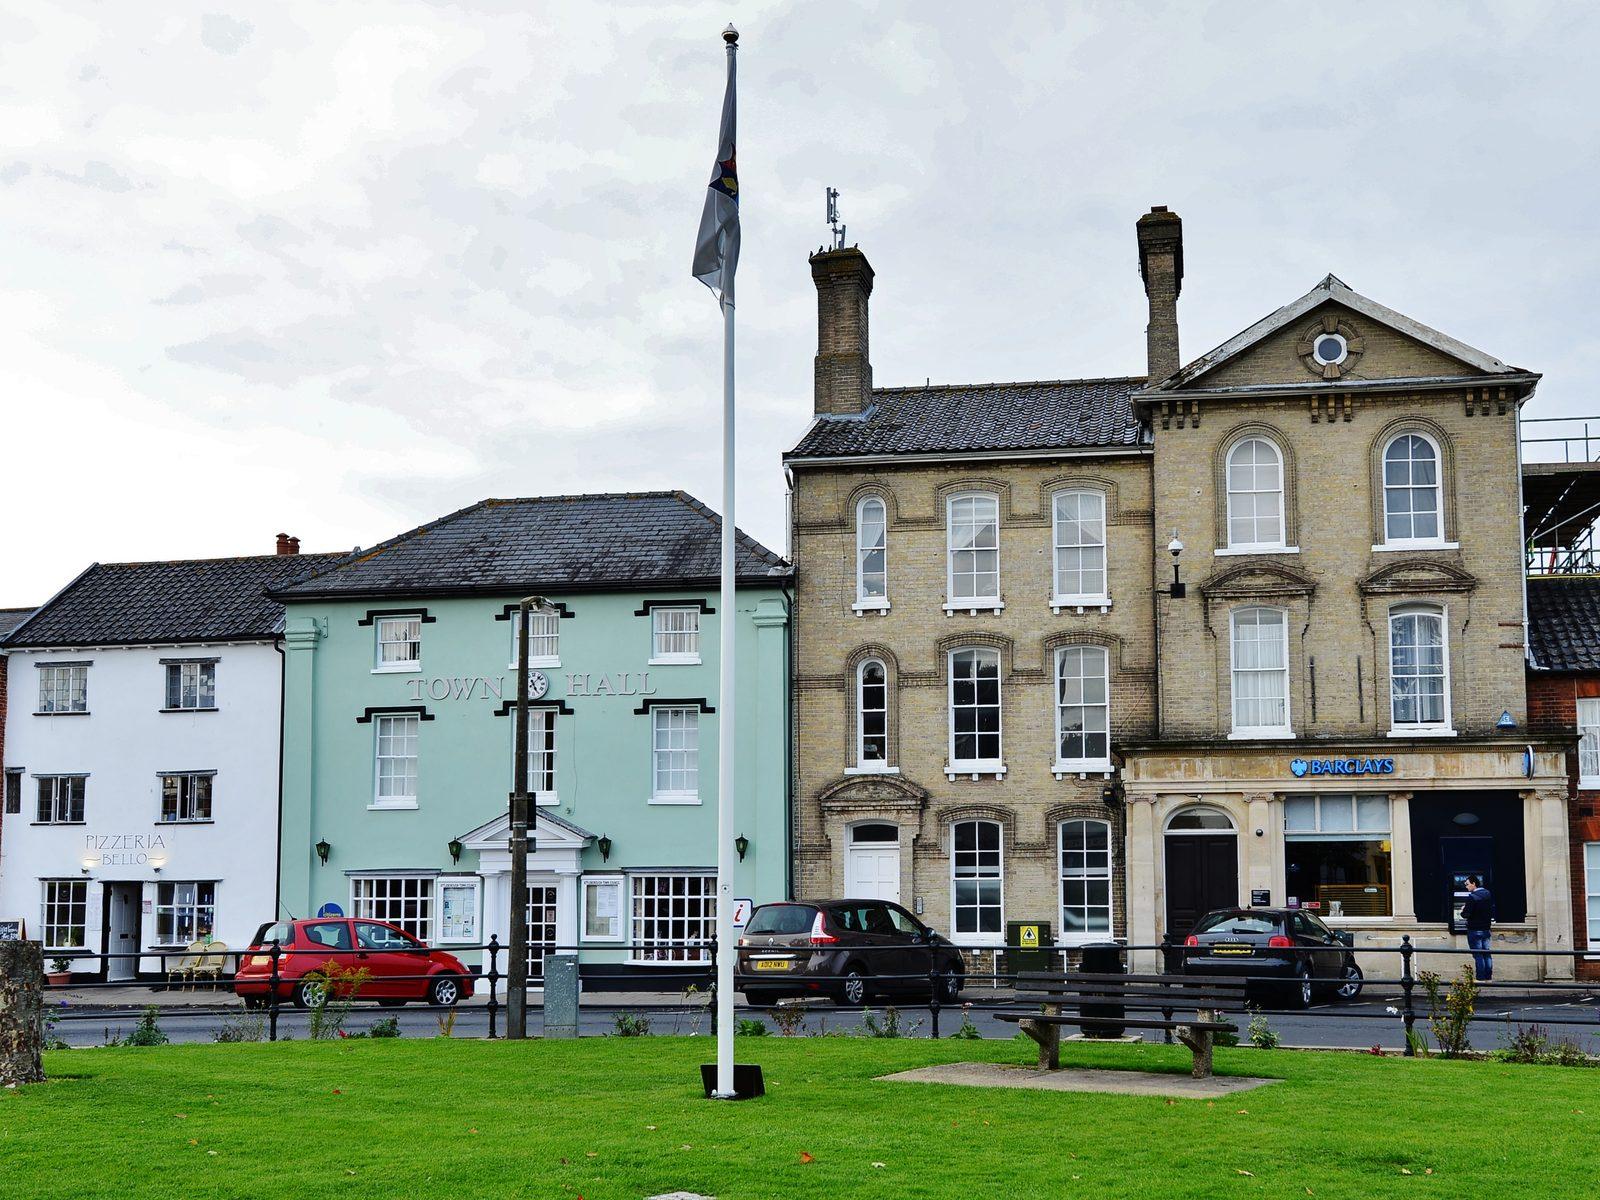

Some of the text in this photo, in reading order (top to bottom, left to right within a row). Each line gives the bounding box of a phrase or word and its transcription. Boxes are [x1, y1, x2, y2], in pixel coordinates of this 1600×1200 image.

[407, 671, 657, 700] TOWN HALL
[1311, 758, 1394, 775] BARCLAYS
[86, 834, 165, 849] PIZZERIA
[102, 852, 148, 865] BELLO
